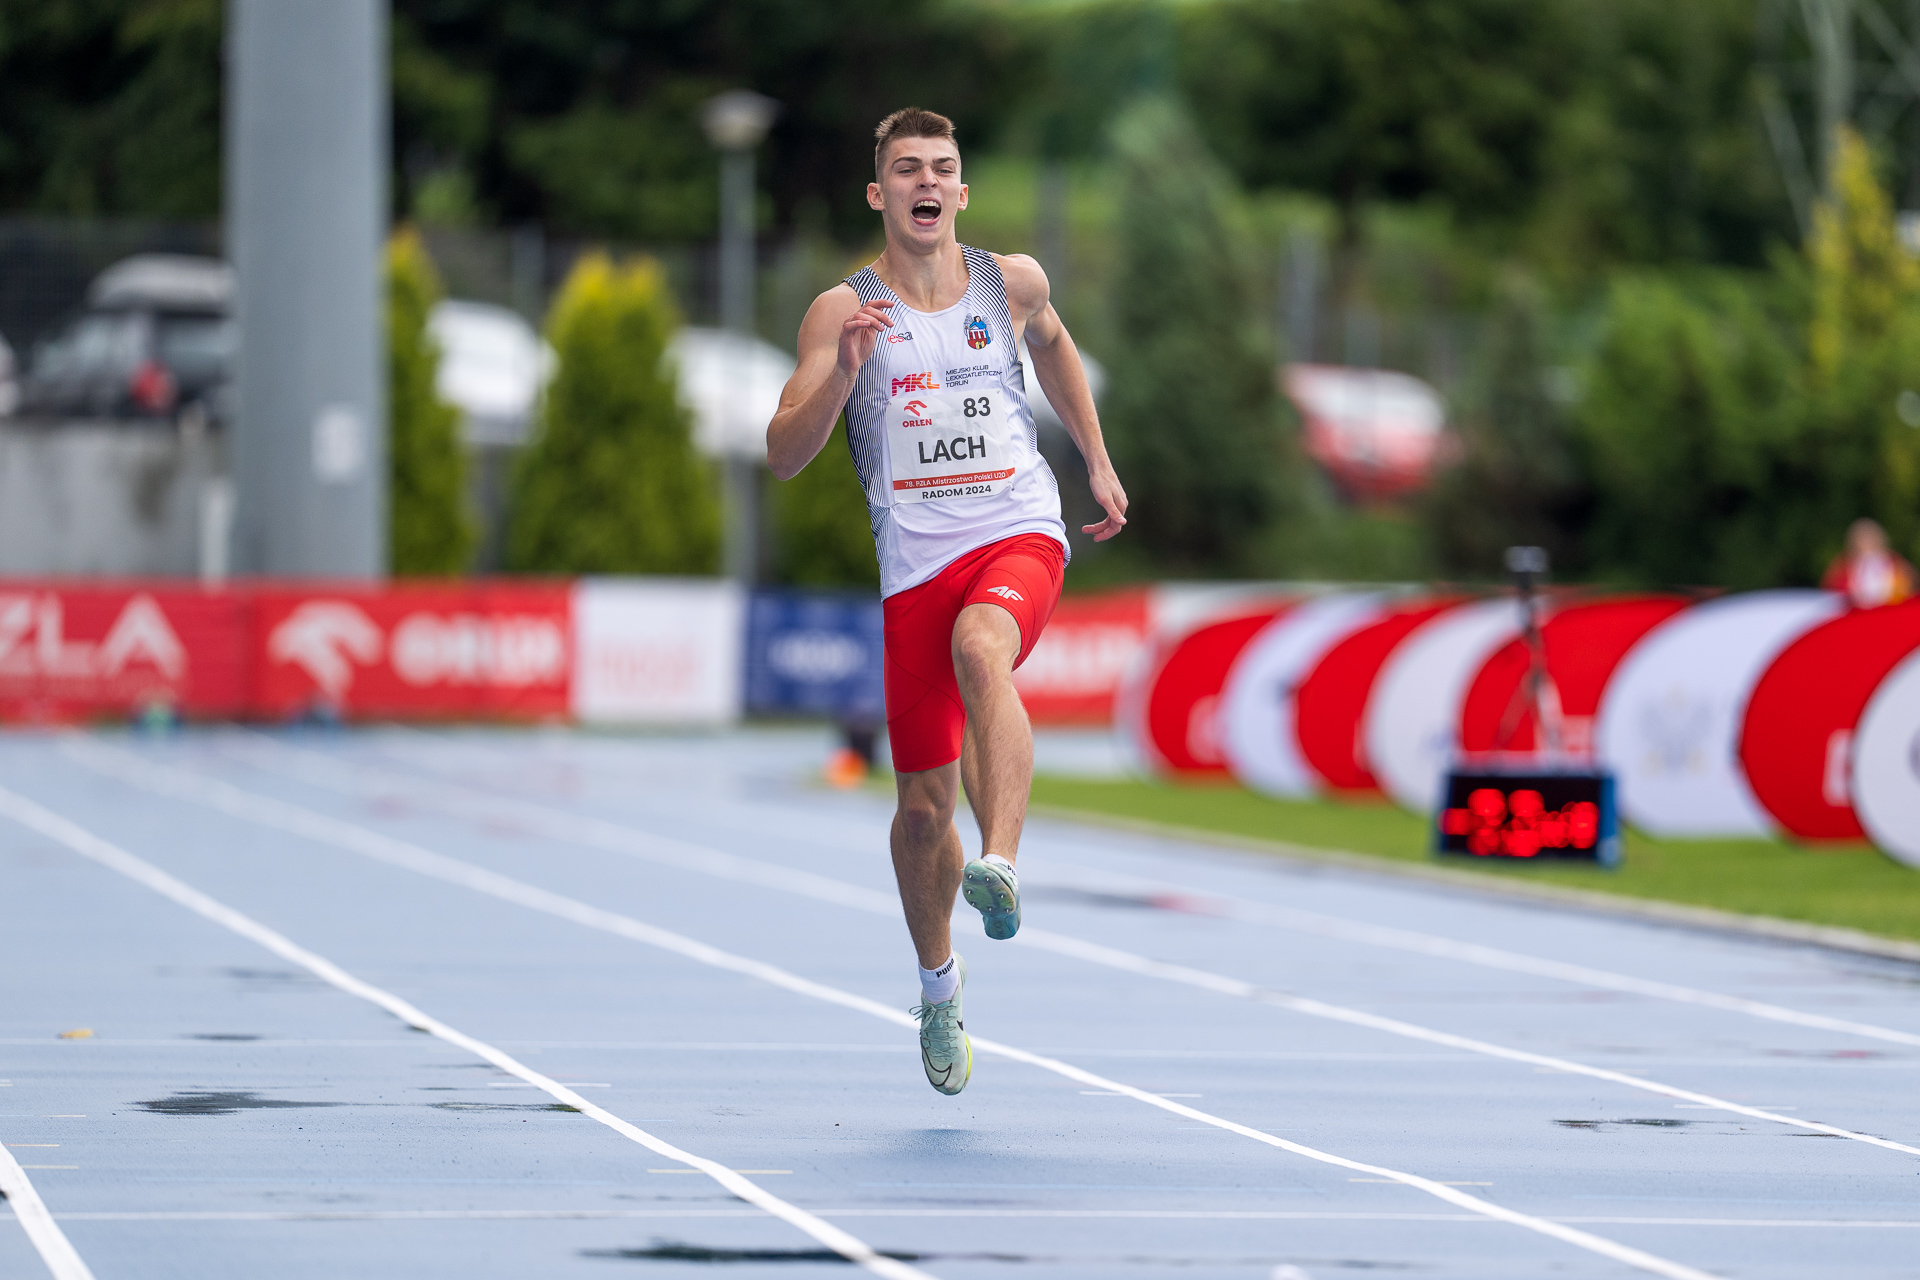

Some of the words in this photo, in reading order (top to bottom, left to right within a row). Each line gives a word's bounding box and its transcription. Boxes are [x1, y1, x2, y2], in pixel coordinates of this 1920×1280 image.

[945, 367, 971, 376] MIEJSKI
[891, 372, 940, 396] MKL
[963, 396, 991, 418] 83
[902, 418, 932, 428] ORLEN
[918, 435, 987, 464] LACH
[932, 475, 973, 486] Mistrzostwa
[974, 472, 993, 481] Polski
[994, 471, 1006, 479] U20
[922, 487, 963, 499] RADOM
[965, 484, 992, 495] 2024
[986, 585, 1024, 601] 4F
[935, 957, 955, 978] PUMA
